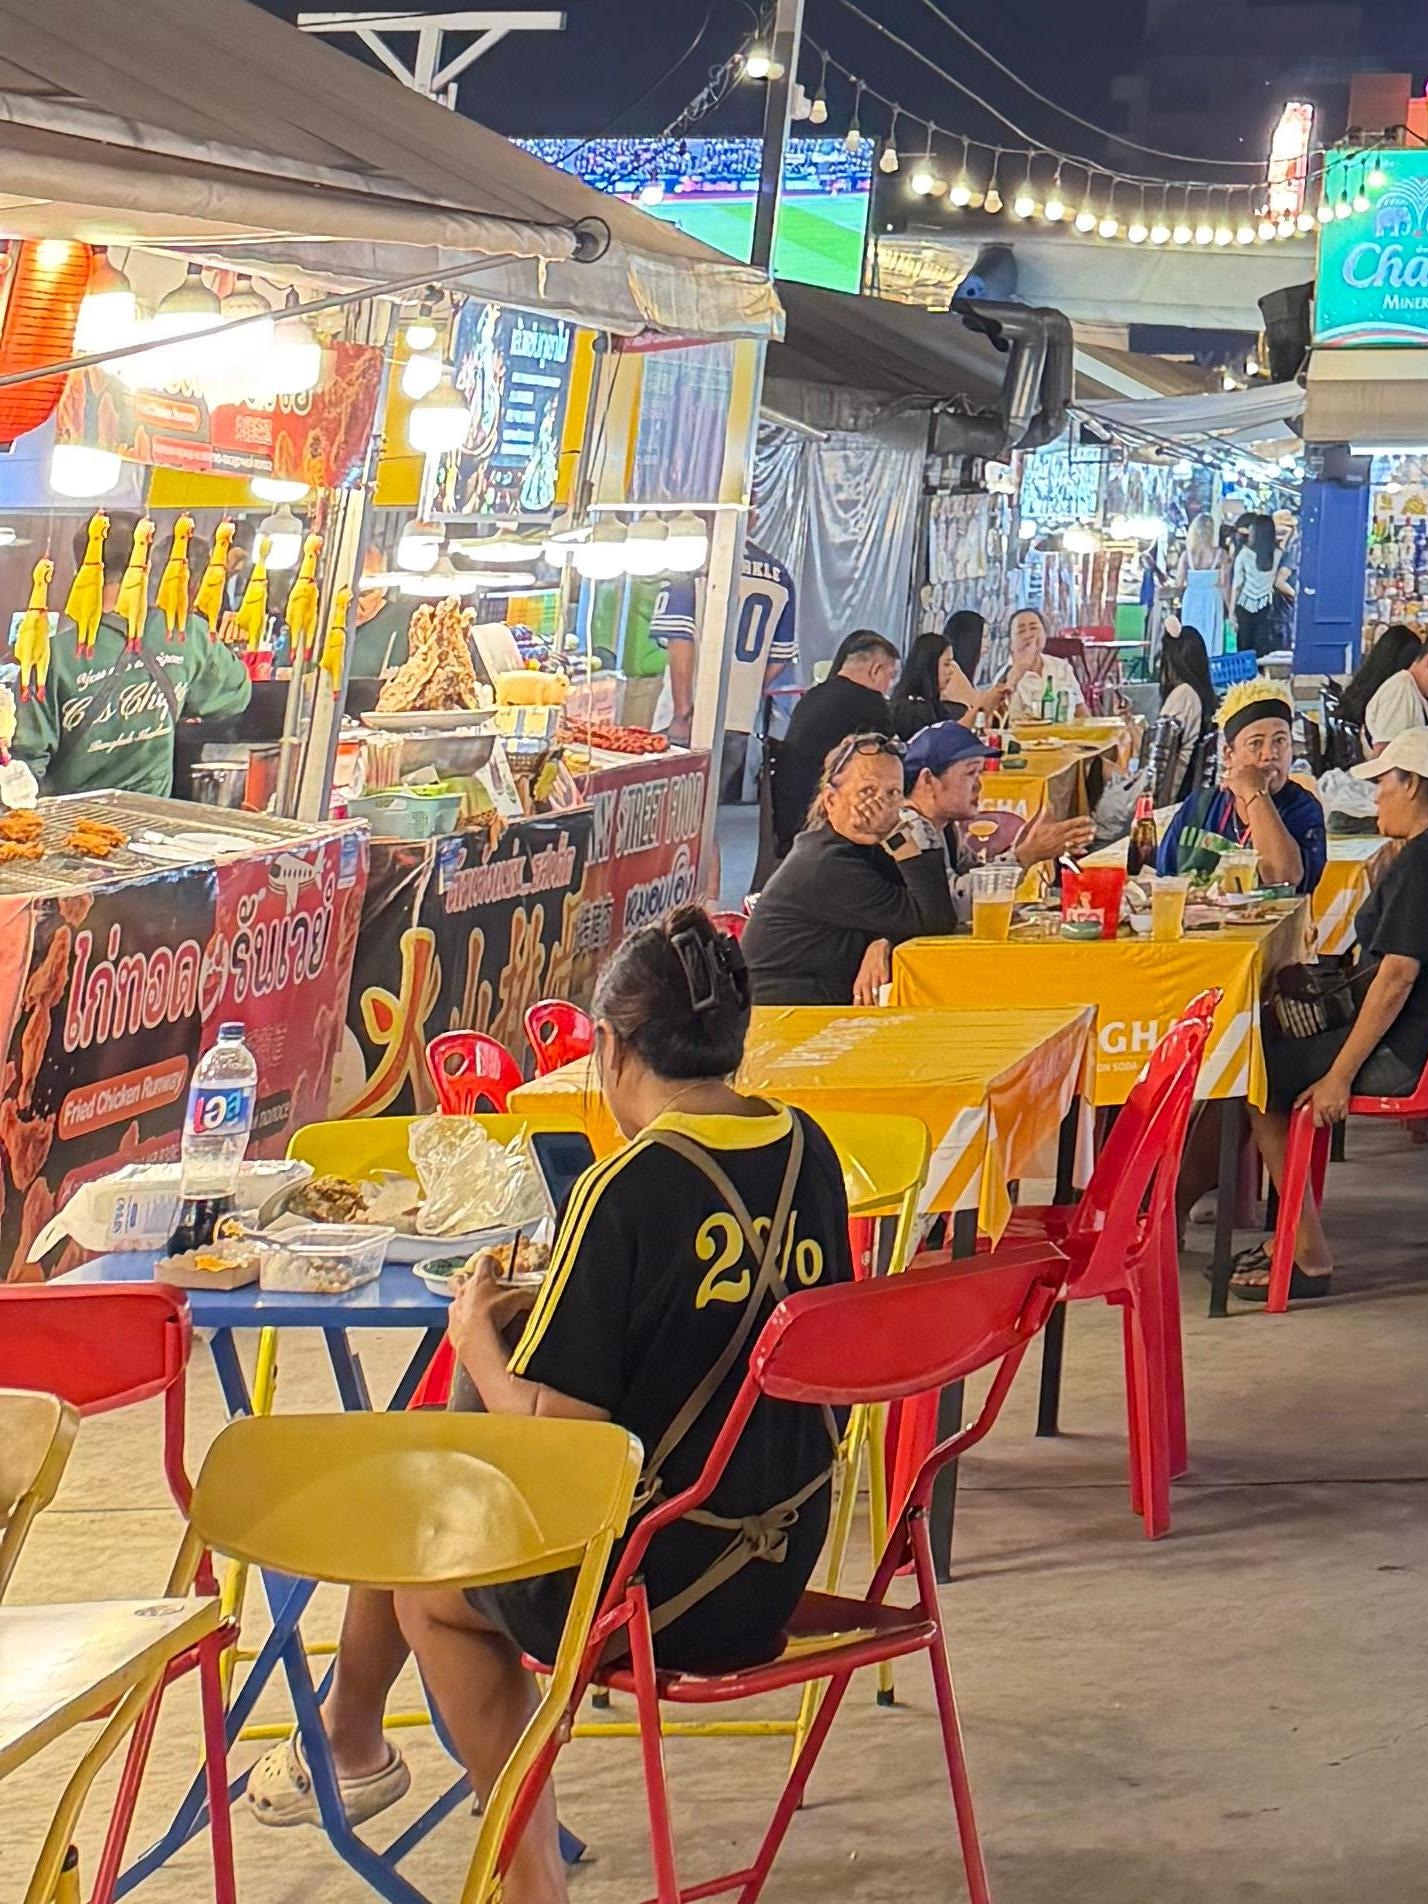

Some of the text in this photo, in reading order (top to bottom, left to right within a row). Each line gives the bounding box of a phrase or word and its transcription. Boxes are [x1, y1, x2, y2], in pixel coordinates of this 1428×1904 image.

[616, 779, 668, 858] STREET
[666, 772, 705, 843] FOOD
[64, 923, 201, 1053] ไก่ทอด
[65, 1096, 94, 1127] Fried
